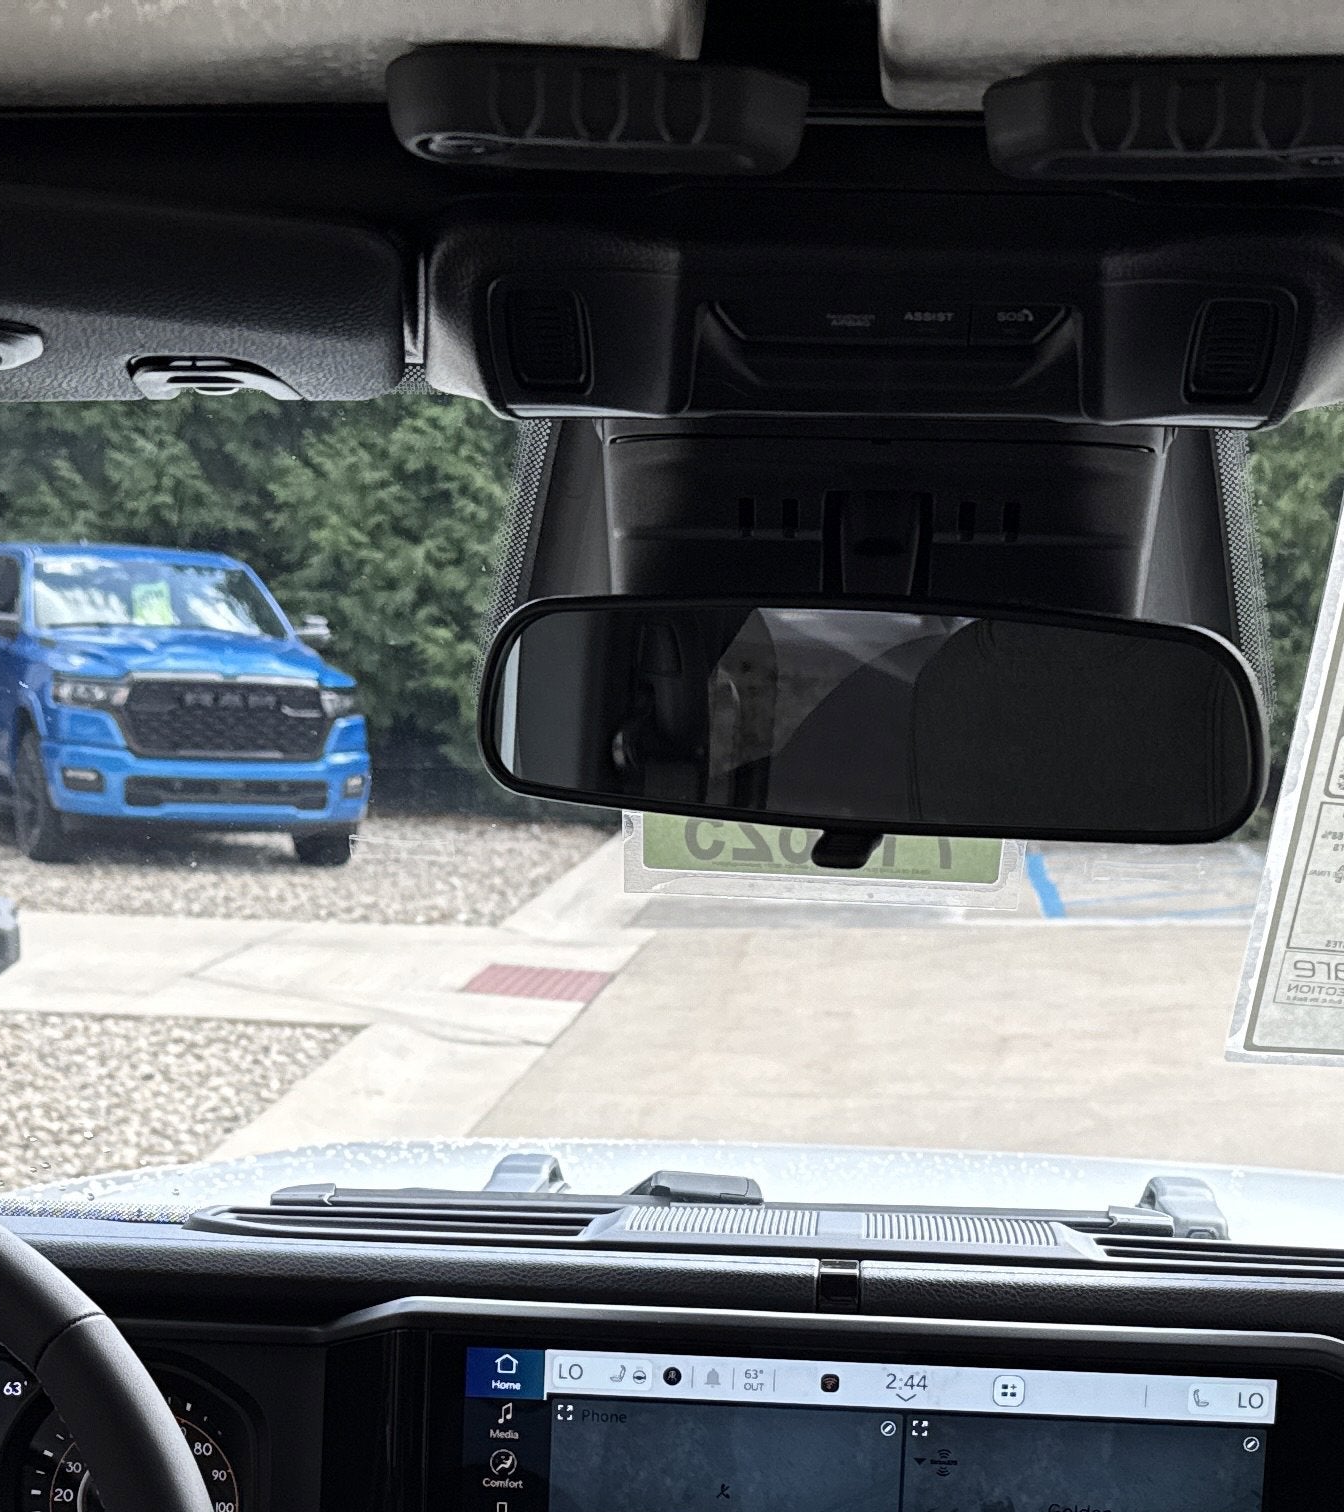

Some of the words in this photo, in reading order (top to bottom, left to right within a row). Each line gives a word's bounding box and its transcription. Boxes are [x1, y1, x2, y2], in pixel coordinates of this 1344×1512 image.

[904, 311, 956, 322] ASSIST
[558, 1363, 584, 1381] LO
[744, 1368, 765, 1381] 63°
[491, 1379, 522, 1391] Home
[743, 1381, 765, 1392] OUT
[884, 1372, 929, 1392] 2:44
[1238, 1391, 1264, 1409] LO
[581, 1408, 628, 1425] Phone
[489, 1429, 520, 1440] Media
[193, 1442, 213, 1456] 80
[65, 1461, 82, 1474] 30
[211, 1469, 228, 1481] 90
[482, 1477, 524, 1489] Comfort
[53, 1488, 74, 1502] 20
